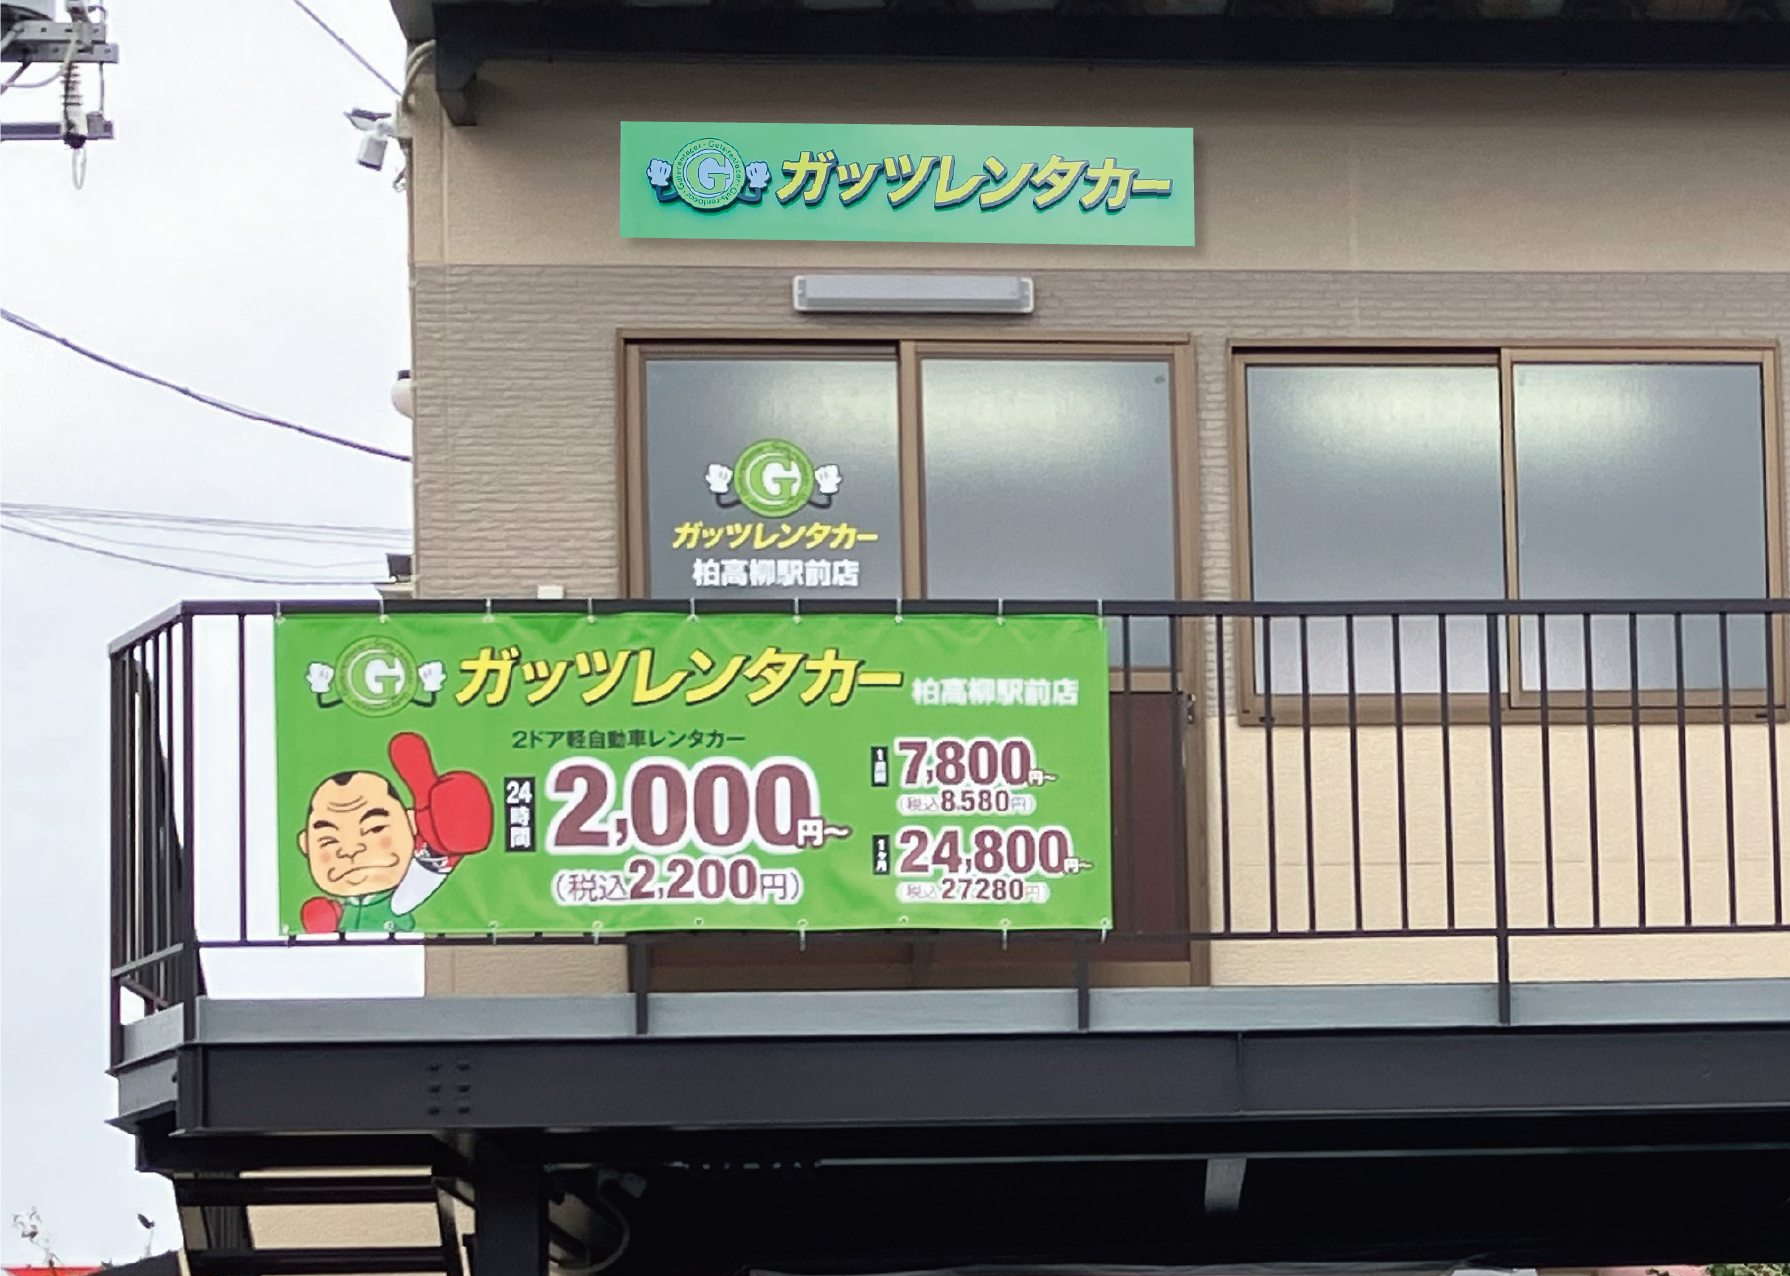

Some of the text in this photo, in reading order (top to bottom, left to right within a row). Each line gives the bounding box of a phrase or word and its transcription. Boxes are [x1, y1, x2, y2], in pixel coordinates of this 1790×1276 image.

[684, 151, 732, 196] G
[774, 149, 1172, 210] ガッツレンタカー
[748, 455, 799, 503] G
[672, 521, 878, 550] ガッツレンタカー
[692, 557, 860, 587] 柏高柳駅前店
[350, 652, 402, 700] G
[455, 645, 904, 707] ガッツレンタカー
[911, 677, 1079, 706] 柏高柳駅前店
[512, 729, 746, 749] 2ドア軽自動車レンタカー
